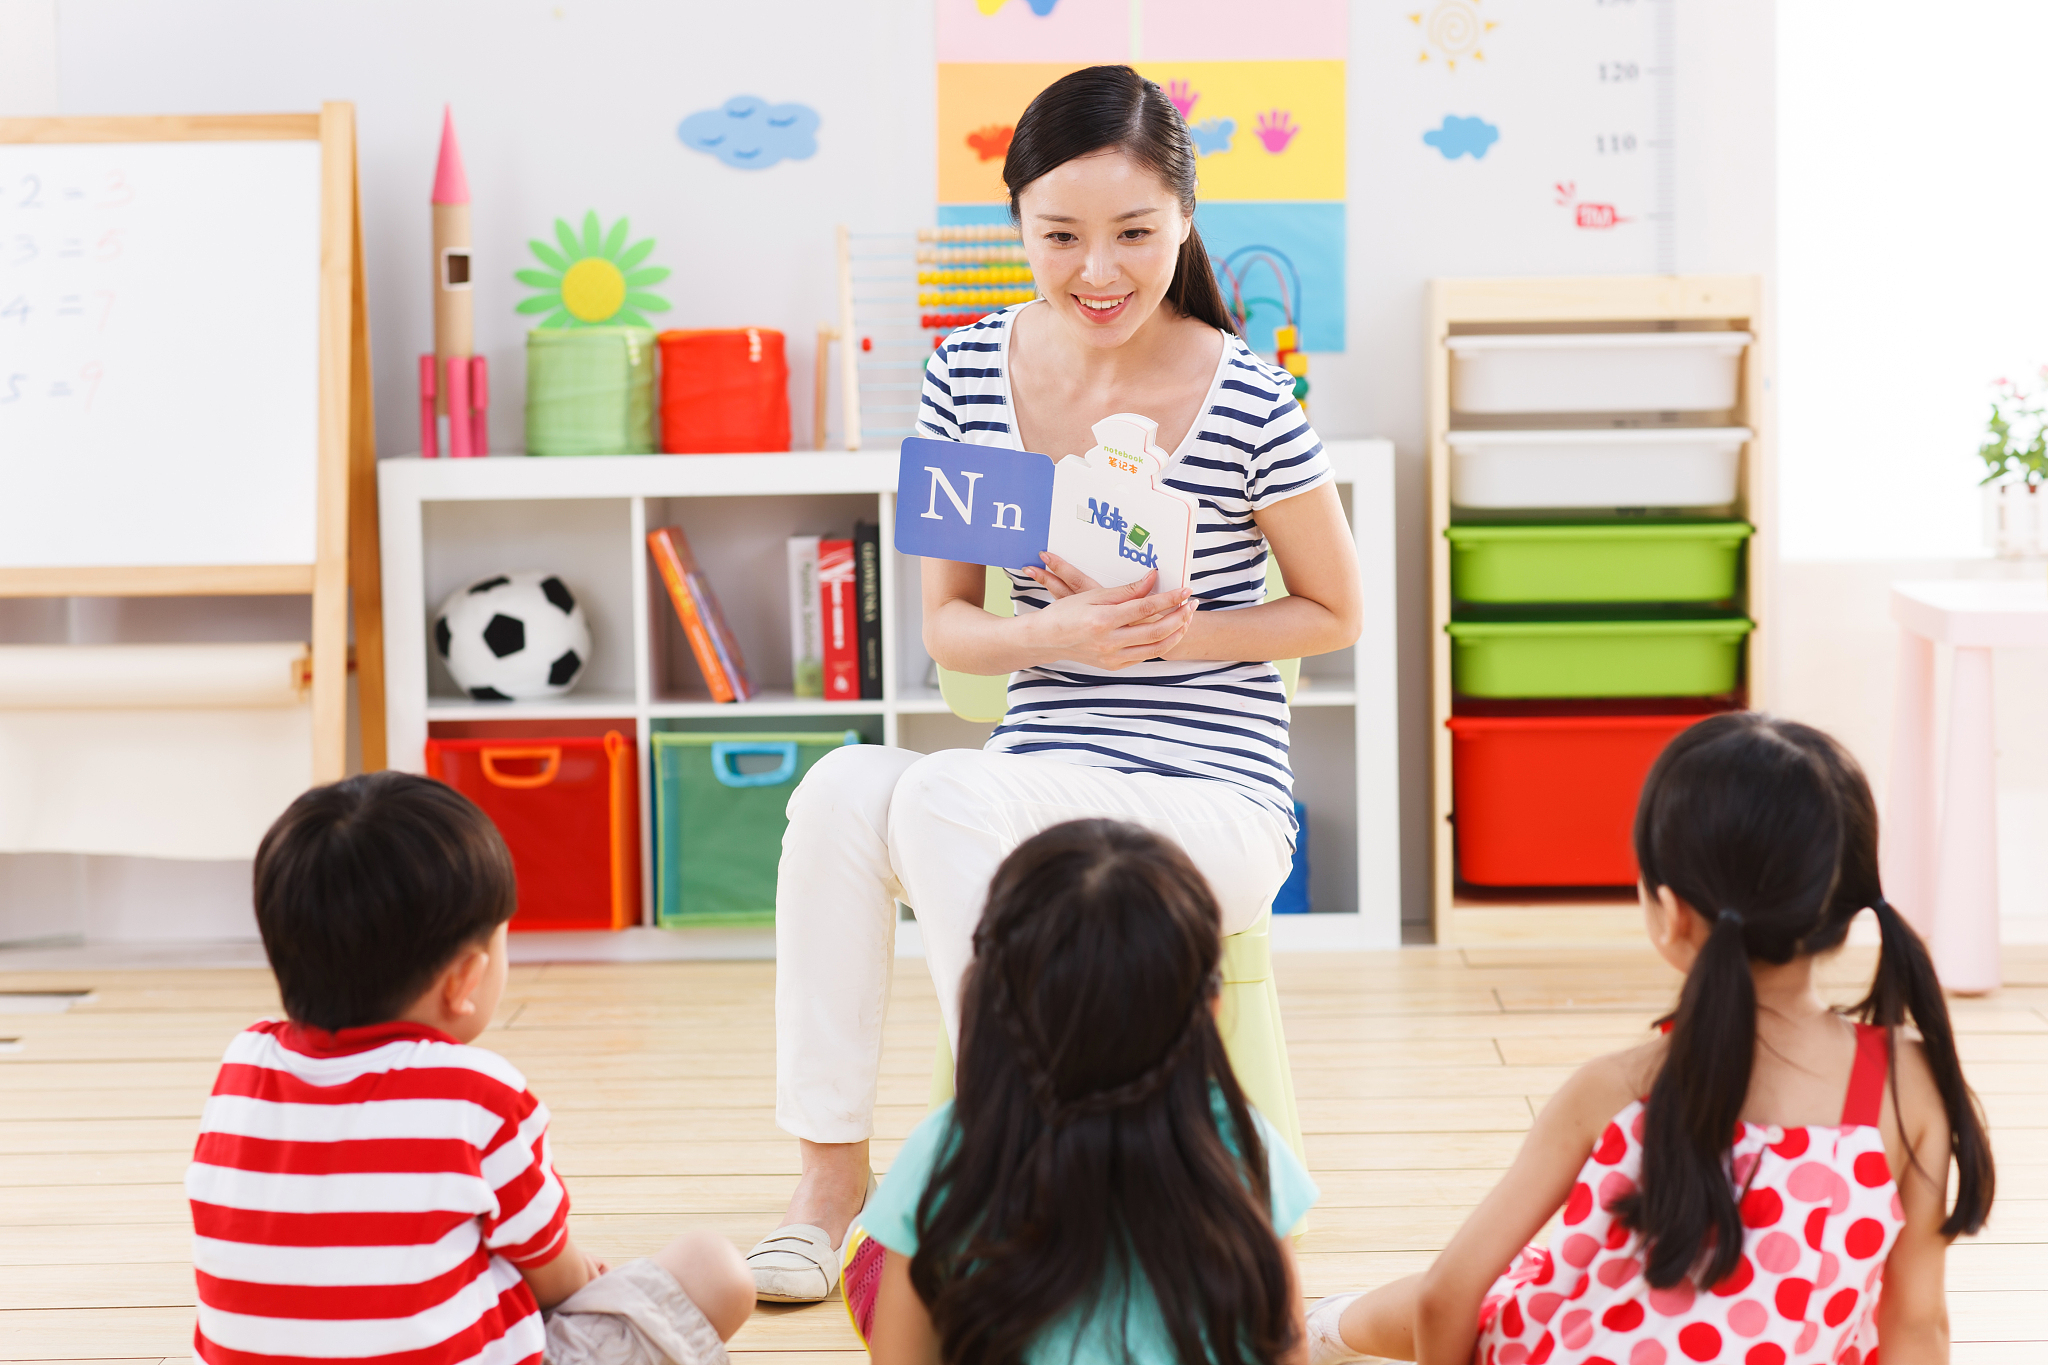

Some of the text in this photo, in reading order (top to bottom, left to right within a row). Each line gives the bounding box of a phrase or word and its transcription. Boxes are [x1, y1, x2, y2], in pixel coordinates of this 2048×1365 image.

[1598, 61, 1639, 82] 120
[1596, 134, 1637, 154] 110
[17, 173, 44, 209] 2
[94, 168, 136, 210] 3
[11, 233, 41, 267] 3
[94, 228, 127, 263] 5
[0, 293, 34, 326] 4
[93, 289, 117, 334] 7
[0, 371, 29, 404] 5
[78, 359, 104, 414] 9
[1103, 445, 1144, 464] notebook
[1108, 456, 1139, 474] 笔记本
[920, 466, 1025, 531] N n
[1088, 497, 1128, 535] Note
[1118, 531, 1158, 571] book
